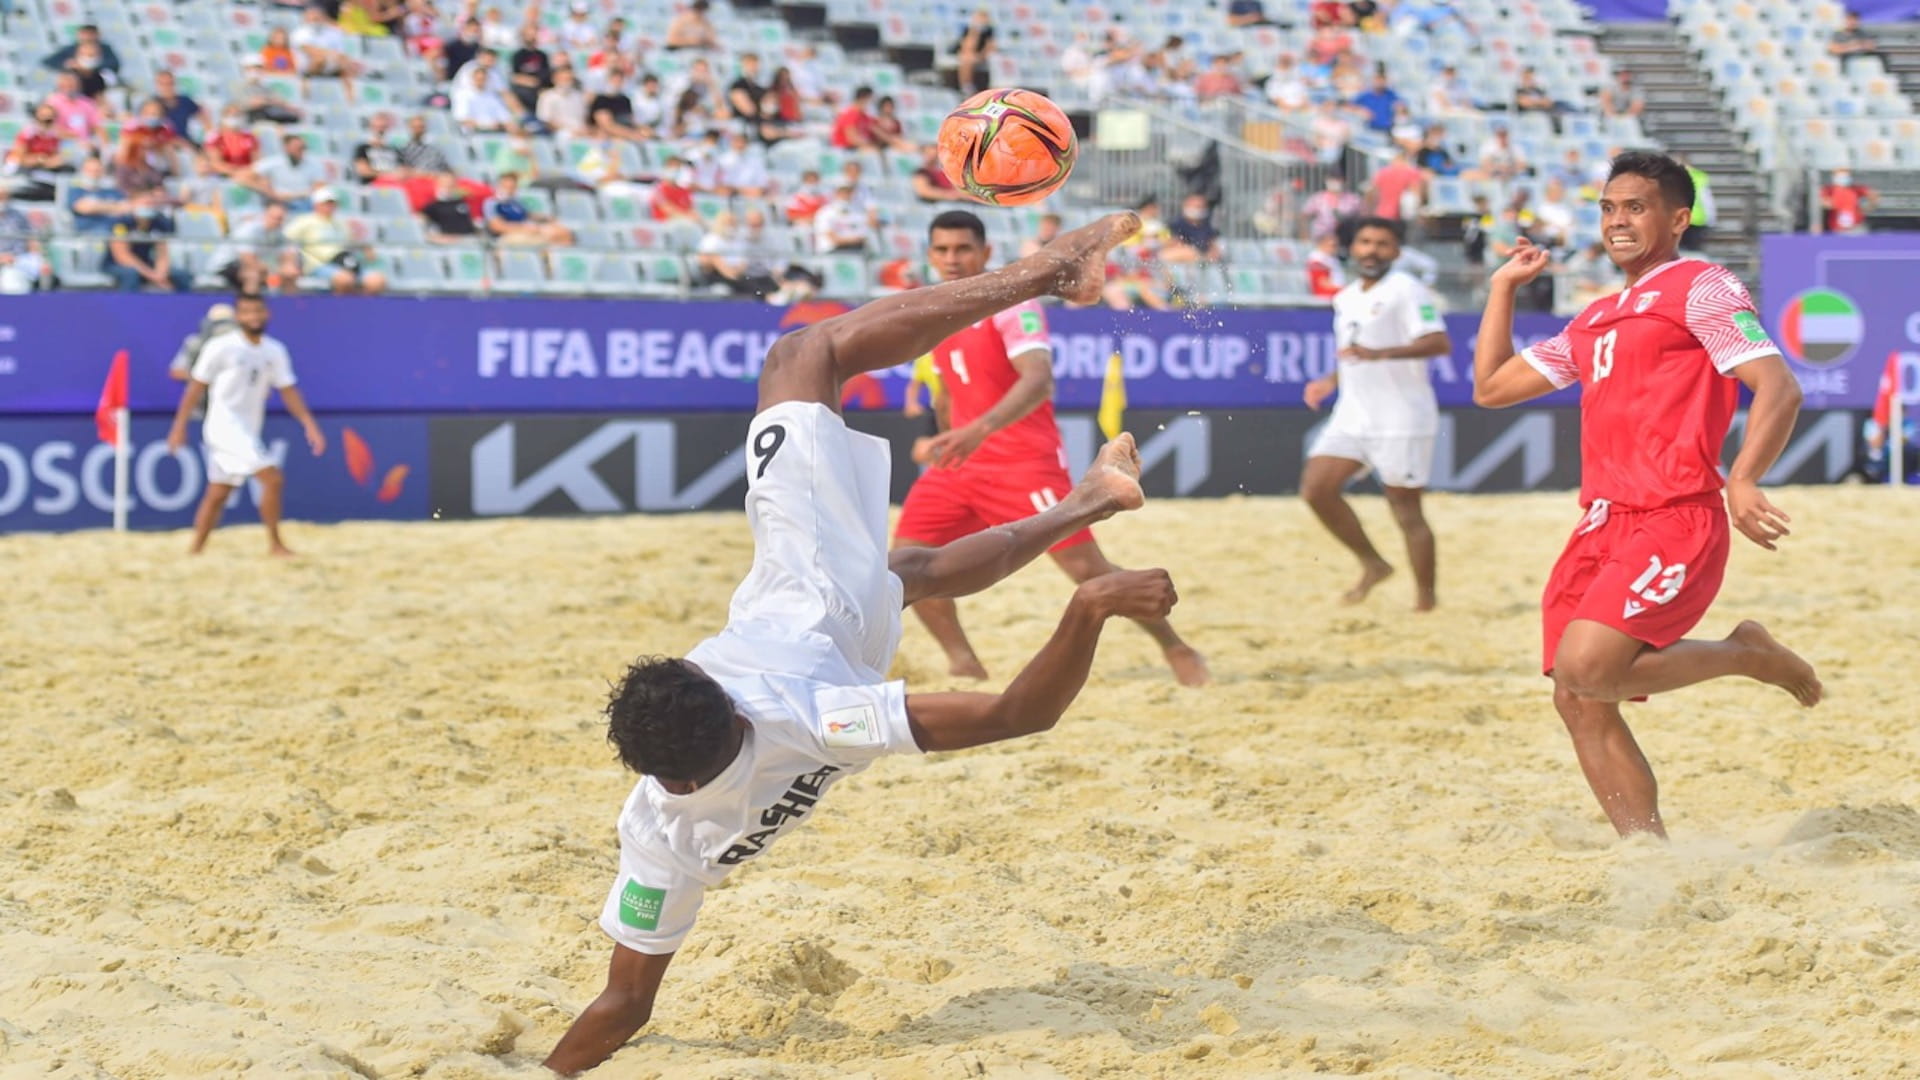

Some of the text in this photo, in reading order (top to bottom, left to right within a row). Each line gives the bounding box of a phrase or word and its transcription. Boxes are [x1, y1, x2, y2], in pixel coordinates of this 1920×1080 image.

[477, 328, 599, 378] FIFA
[606, 330, 775, 378] BEACH
[1162, 334, 1249, 380] CUP
[950, 349, 971, 385] 4
[1592, 328, 1617, 384] 13
[753, 424, 786, 480] 9
[1629, 554, 1687, 605] 13
